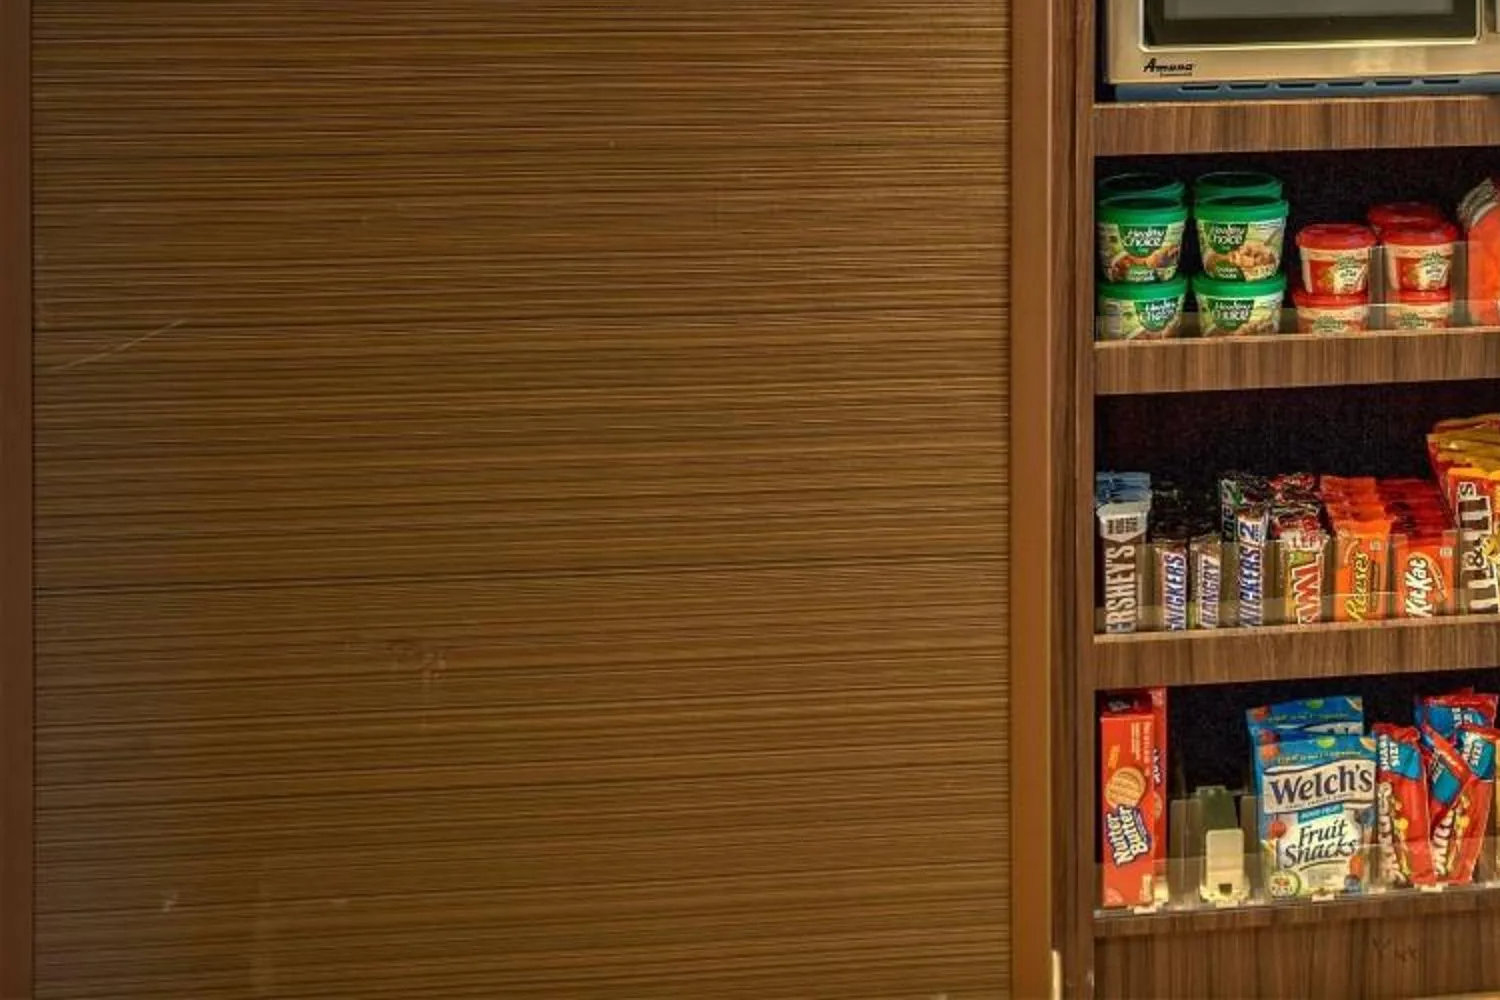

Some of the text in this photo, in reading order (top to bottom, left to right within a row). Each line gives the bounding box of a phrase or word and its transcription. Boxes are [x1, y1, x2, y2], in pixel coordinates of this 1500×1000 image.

[1105, 545, 1136, 634] ERSHEY'S
[1239, 548, 1263, 626] NICKERS
[1268, 763, 1373, 805] Welch's
[1107, 813, 1133, 866] Nutter
[1118, 804, 1149, 856] Butter
[1283, 839, 1358, 869] Snacks
[1299, 819, 1349, 847] Fruit
